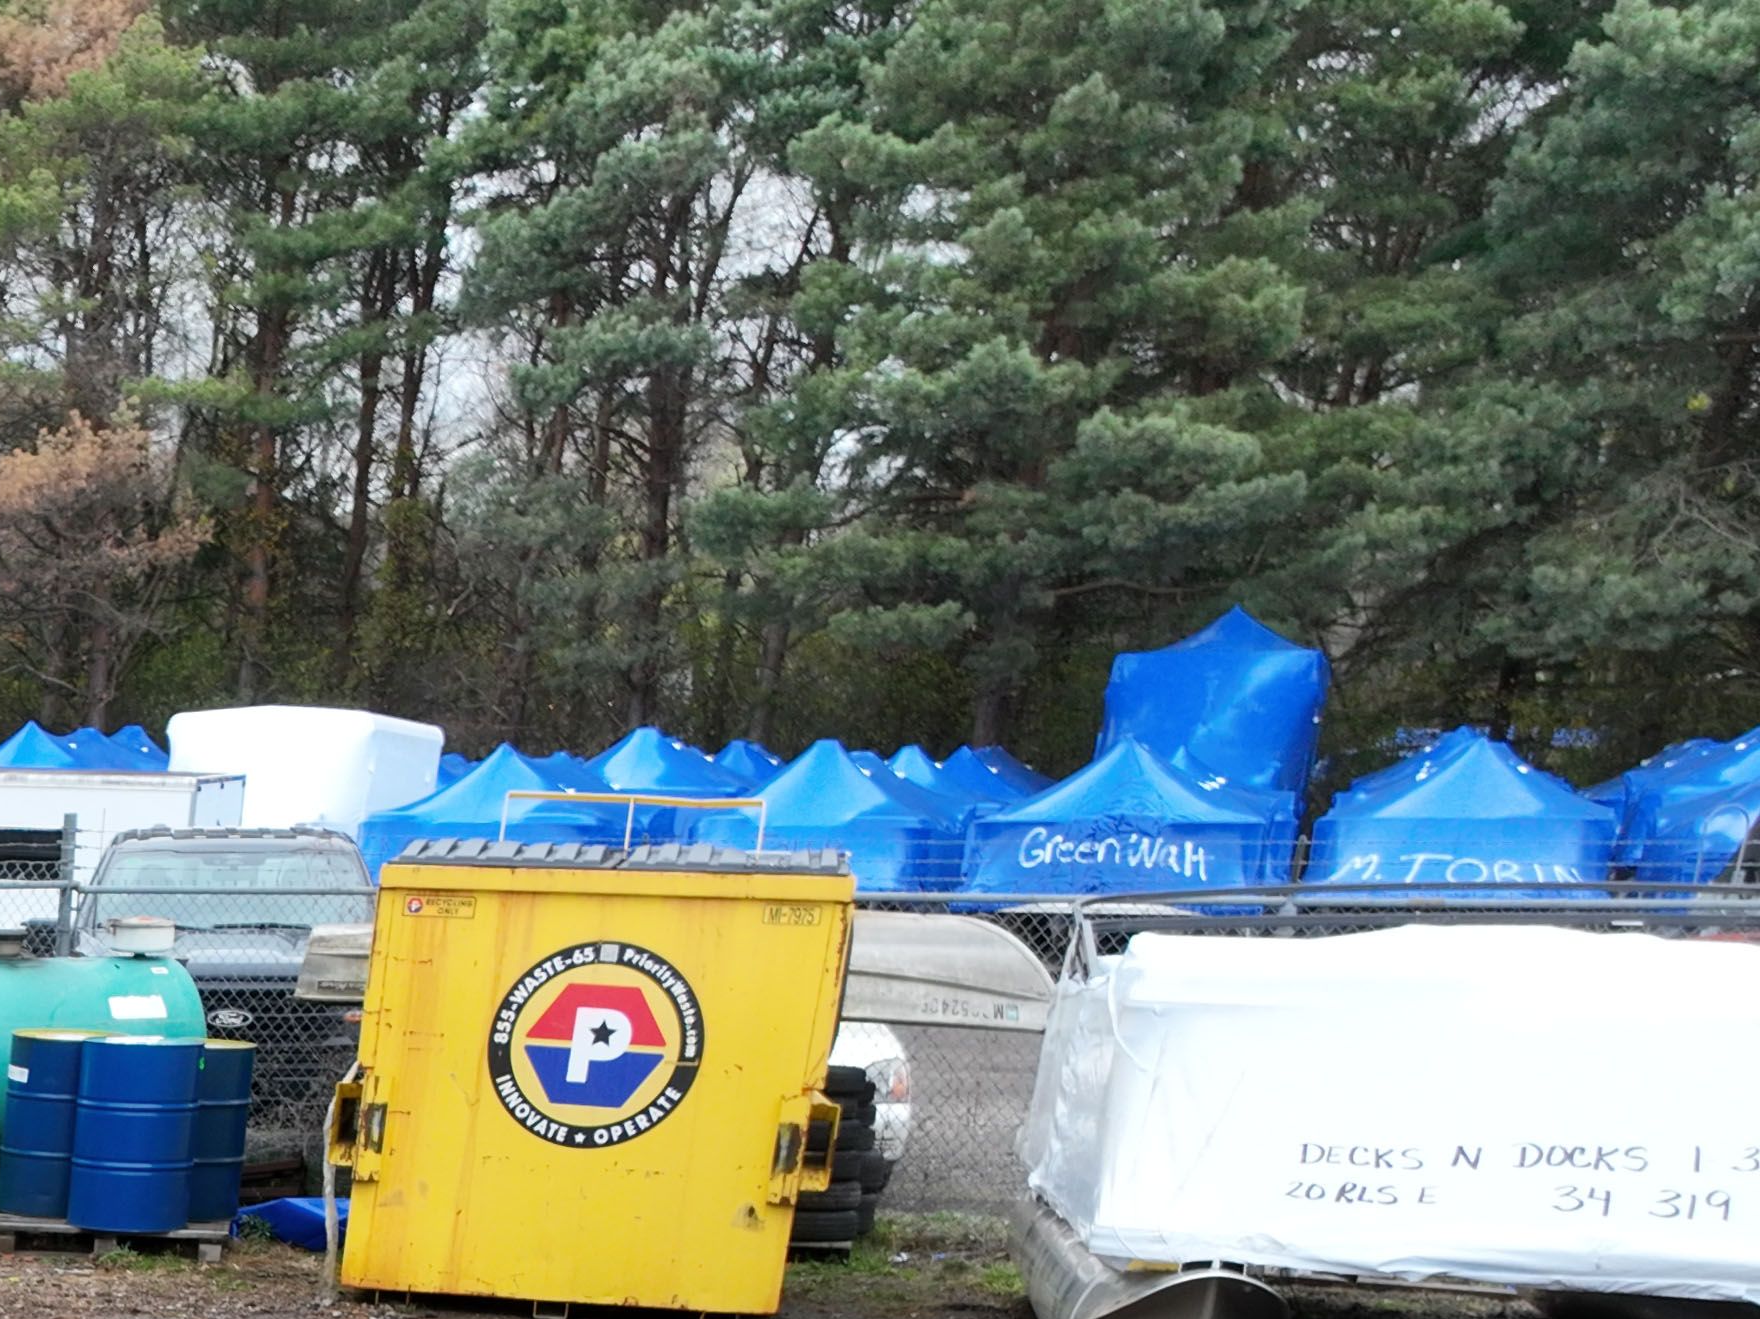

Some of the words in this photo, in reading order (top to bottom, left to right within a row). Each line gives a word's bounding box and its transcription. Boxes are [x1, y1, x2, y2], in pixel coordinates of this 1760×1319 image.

[425, 898, 473, 908] RECYCLING
[437, 907, 459, 915] ONLY
[768, 906, 815, 925] MI-7975
[493, 947, 596, 1045] 855-WASTE-65
[622, 947, 698, 1058] PriorityWaste.com
[565, 1006, 632, 1084] P
[495, 1074, 569, 1143] INNOVATE
[593, 1086, 682, 1145] OPERATE
[1300, 1143, 1424, 1170] DECKS
[1451, 1144, 1483, 1170] N
[1513, 1143, 1649, 1172] DOCKS
[1553, 1185, 1612, 1216] 34
[1648, 1189, 1732, 1221] 319
